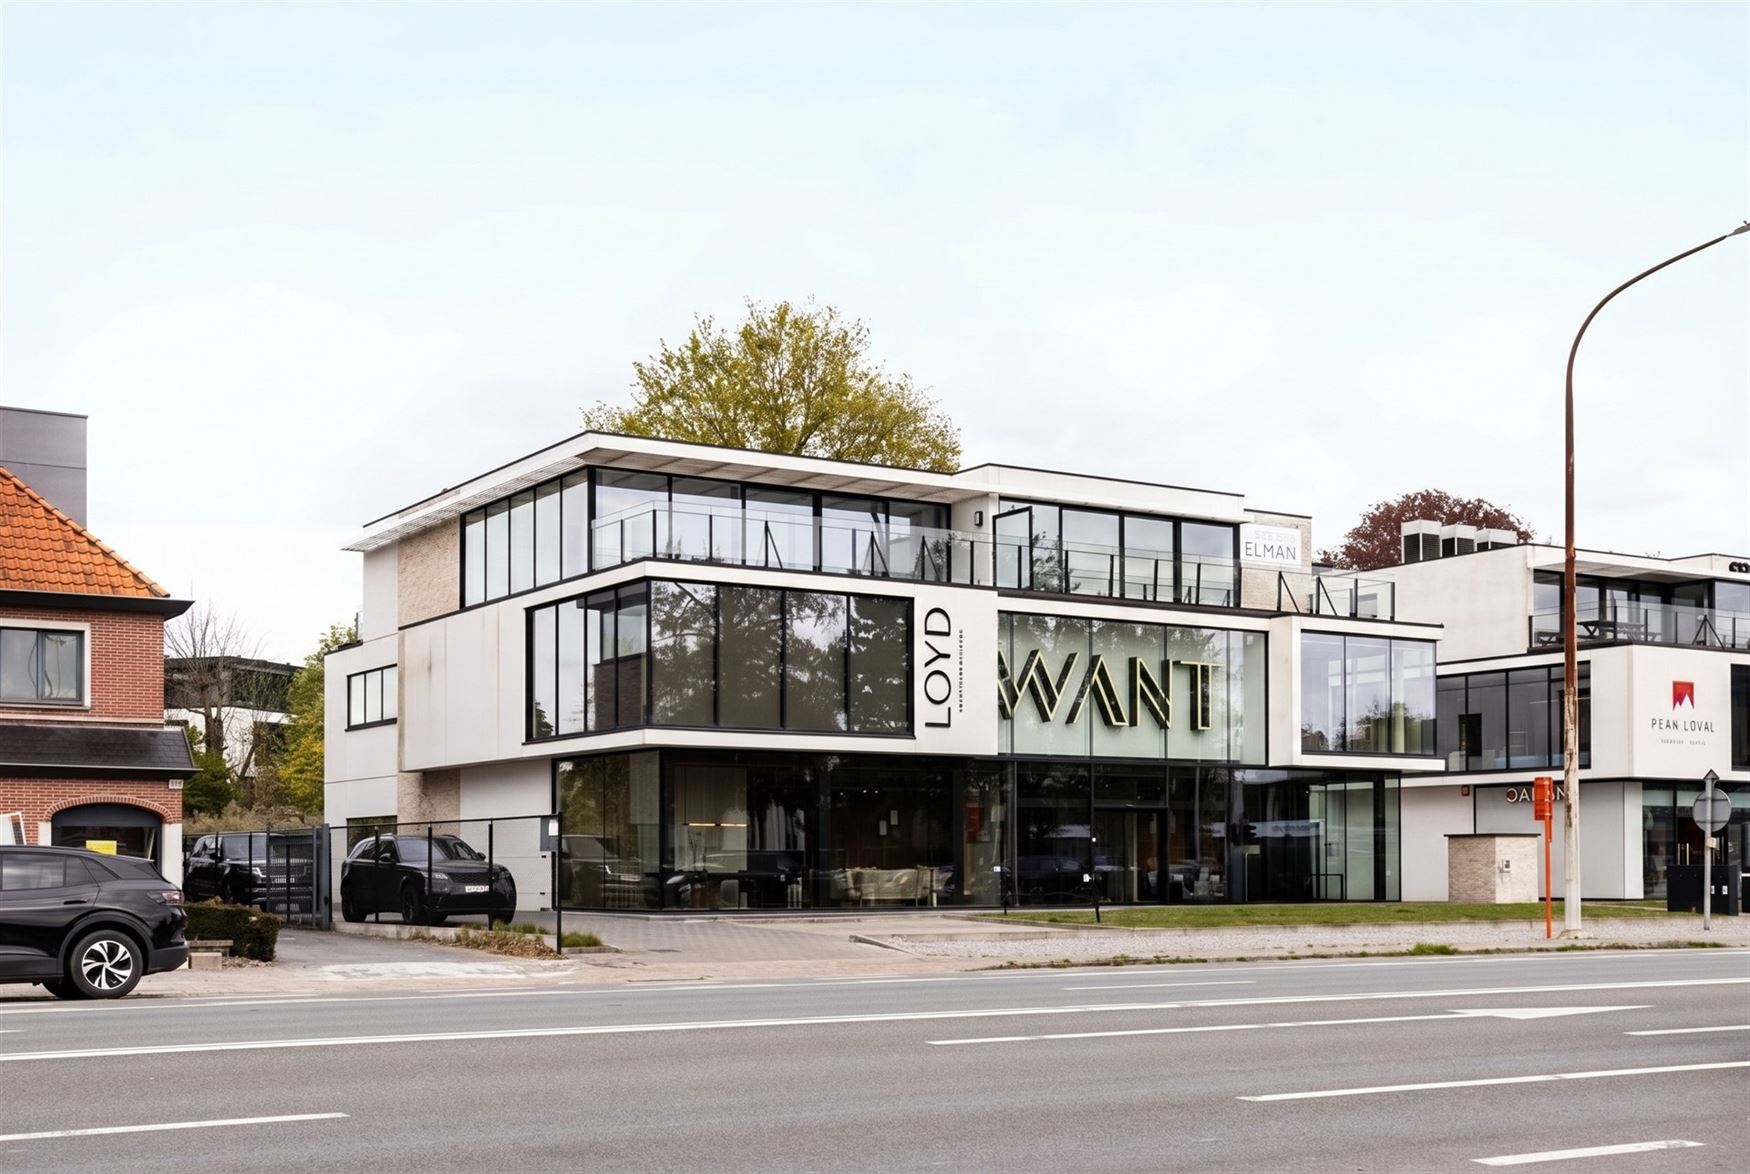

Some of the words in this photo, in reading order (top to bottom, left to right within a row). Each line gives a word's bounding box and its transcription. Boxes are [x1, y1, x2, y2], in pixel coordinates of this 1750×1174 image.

[1245, 541, 1296, 560] ELMAN
[924, 607, 951, 728] LOYD
[998, 649, 1224, 731] WANT
[1651, 718, 1679, 731] PEAN
[1683, 719, 1715, 733] LOVAL
